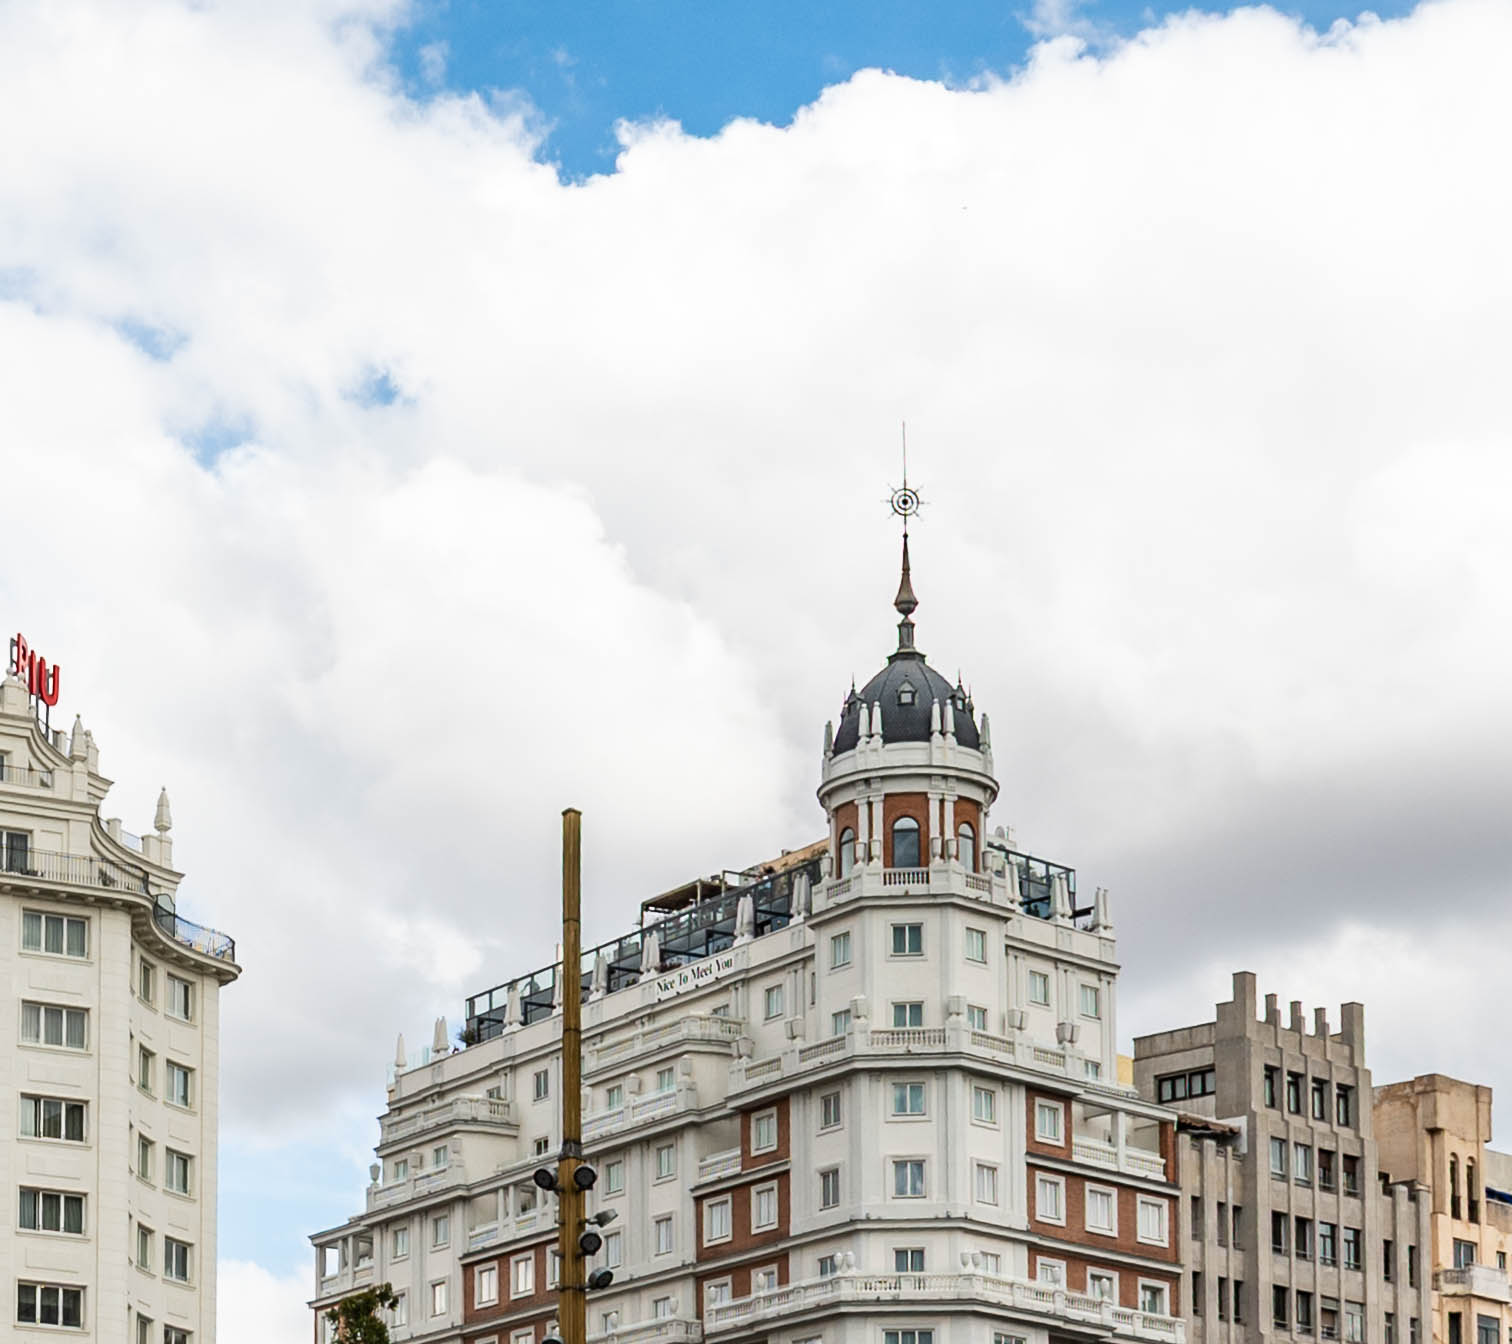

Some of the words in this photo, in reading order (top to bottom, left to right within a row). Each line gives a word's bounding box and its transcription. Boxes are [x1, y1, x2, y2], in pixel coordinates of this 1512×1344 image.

[16, 632, 60, 707] RIU
[657, 978, 676, 993] Nice
[678, 972, 689, 987] To
[691, 963, 713, 980] Meet
[716, 958, 734, 973] You
